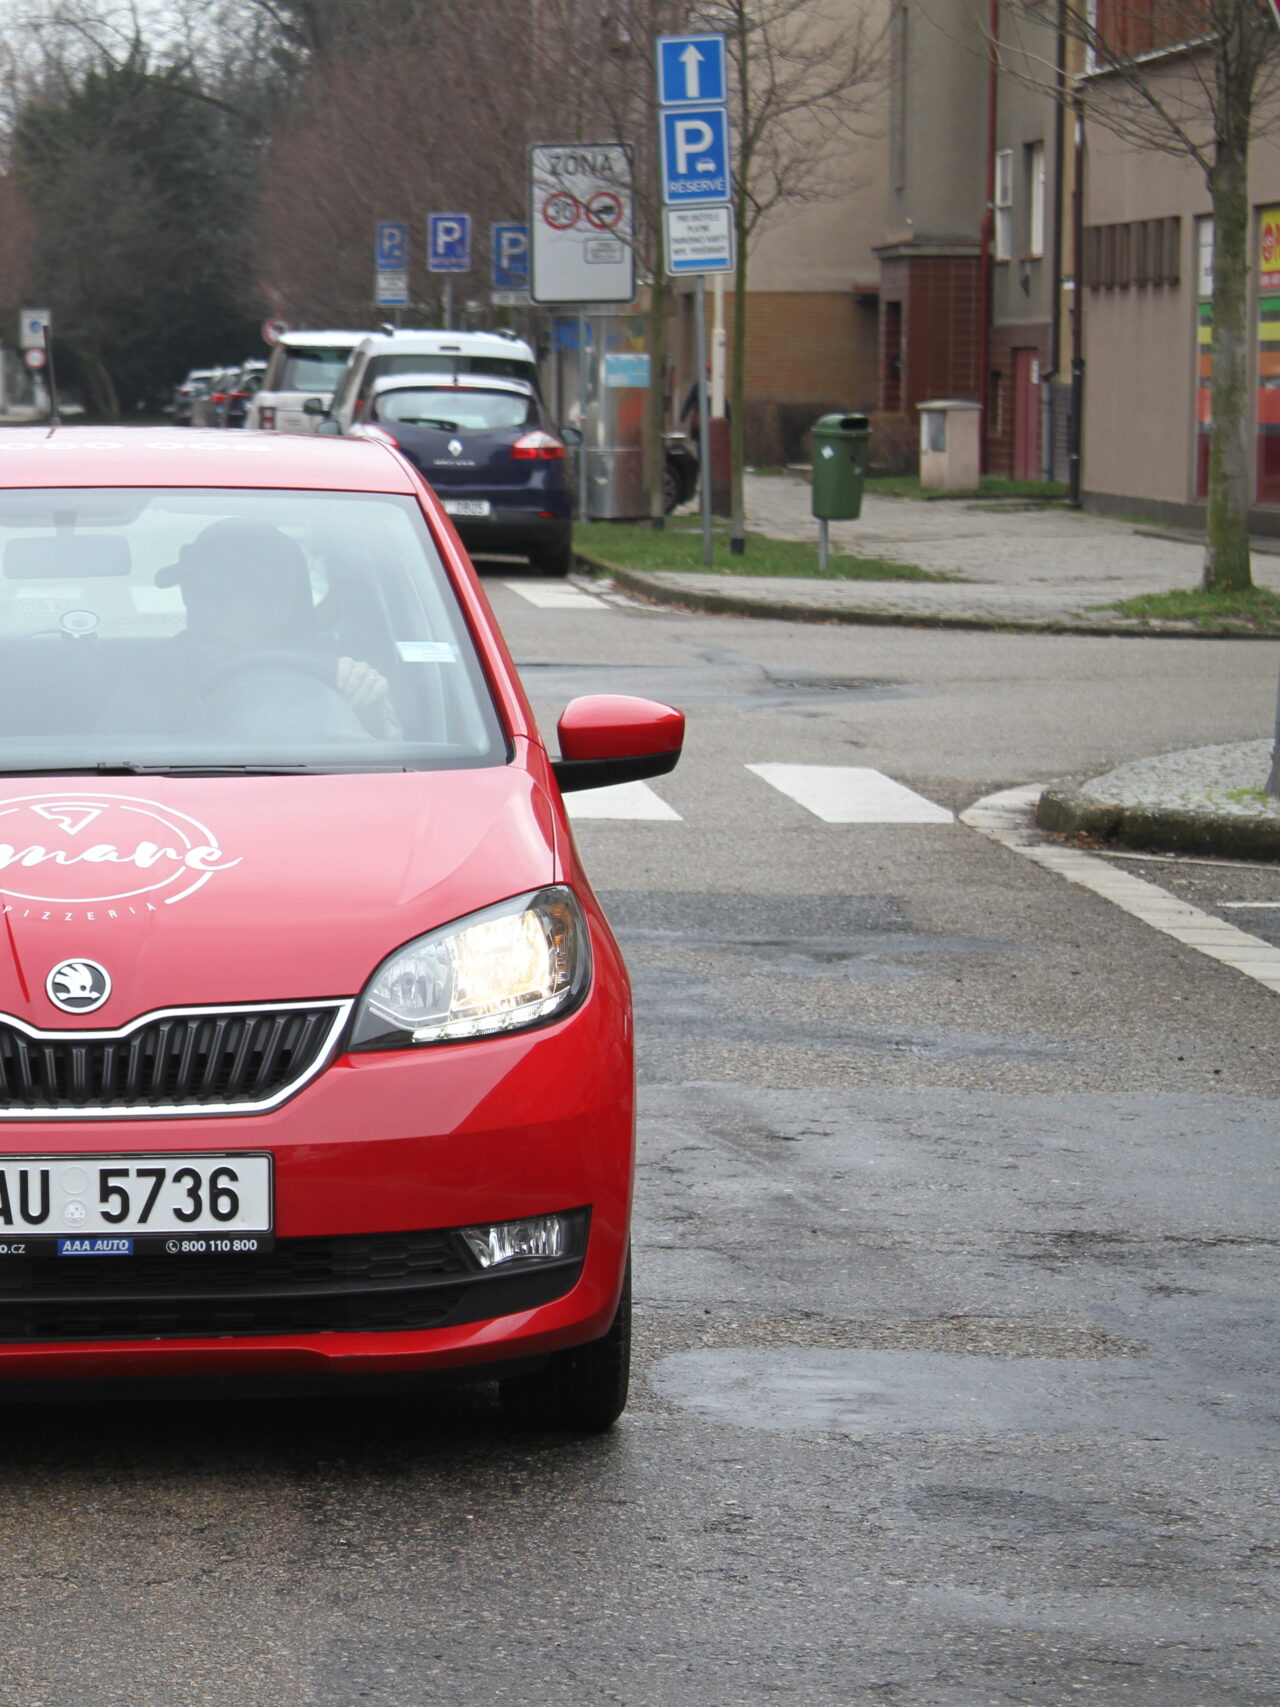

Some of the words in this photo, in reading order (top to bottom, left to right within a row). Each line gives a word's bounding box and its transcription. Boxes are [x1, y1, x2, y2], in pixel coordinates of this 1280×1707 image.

[673, 120, 714, 175] P
[436, 221, 461, 254] P
[3, 903, 157, 921] PIZZERIA
[99, 1166, 240, 1224] 5736
[62, 1240, 91, 1252] AAA
[94, 1240, 129, 1252] AUTO
[181, 1240, 206, 1252] 800
[209, 1240, 229, 1252] 110
[232, 1240, 258, 1252] 800
